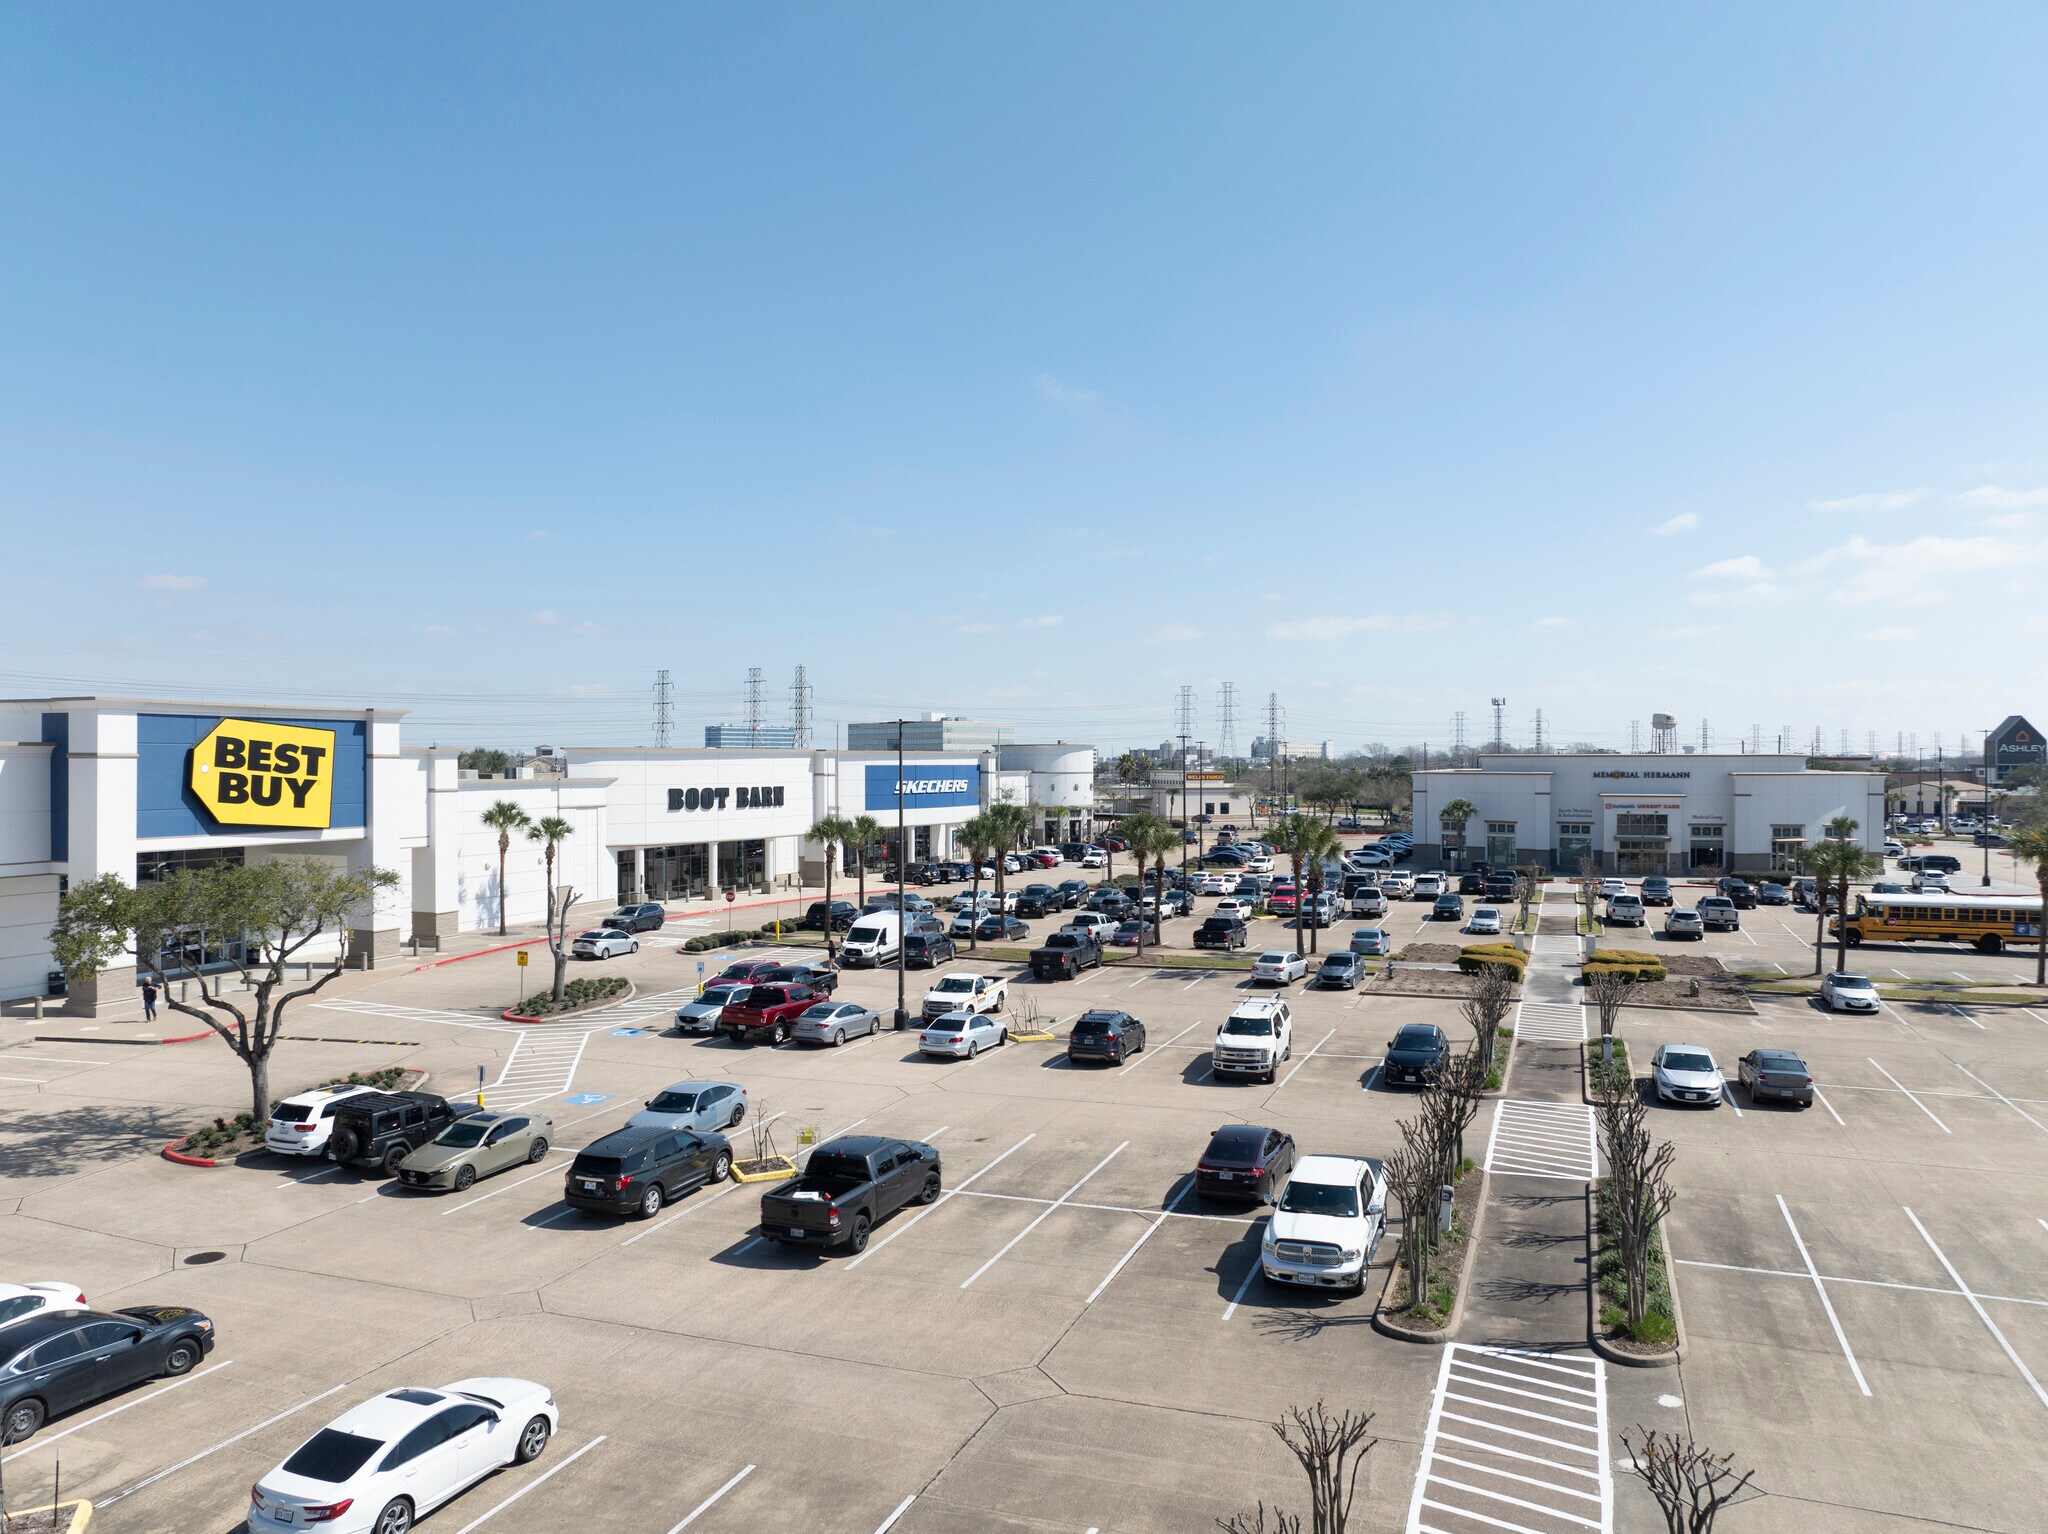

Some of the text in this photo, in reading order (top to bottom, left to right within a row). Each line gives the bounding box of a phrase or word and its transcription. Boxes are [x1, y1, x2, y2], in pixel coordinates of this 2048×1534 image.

[214, 735, 326, 777] BEST
[1999, 744, 2045, 752] ASHLEY
[1593, 770, 1690, 780] MEMORIAL HERMANN
[217, 771, 318, 808] BUY
[893, 779, 969, 795] SKECHERS
[668, 786, 784, 811] BOOT BARN
